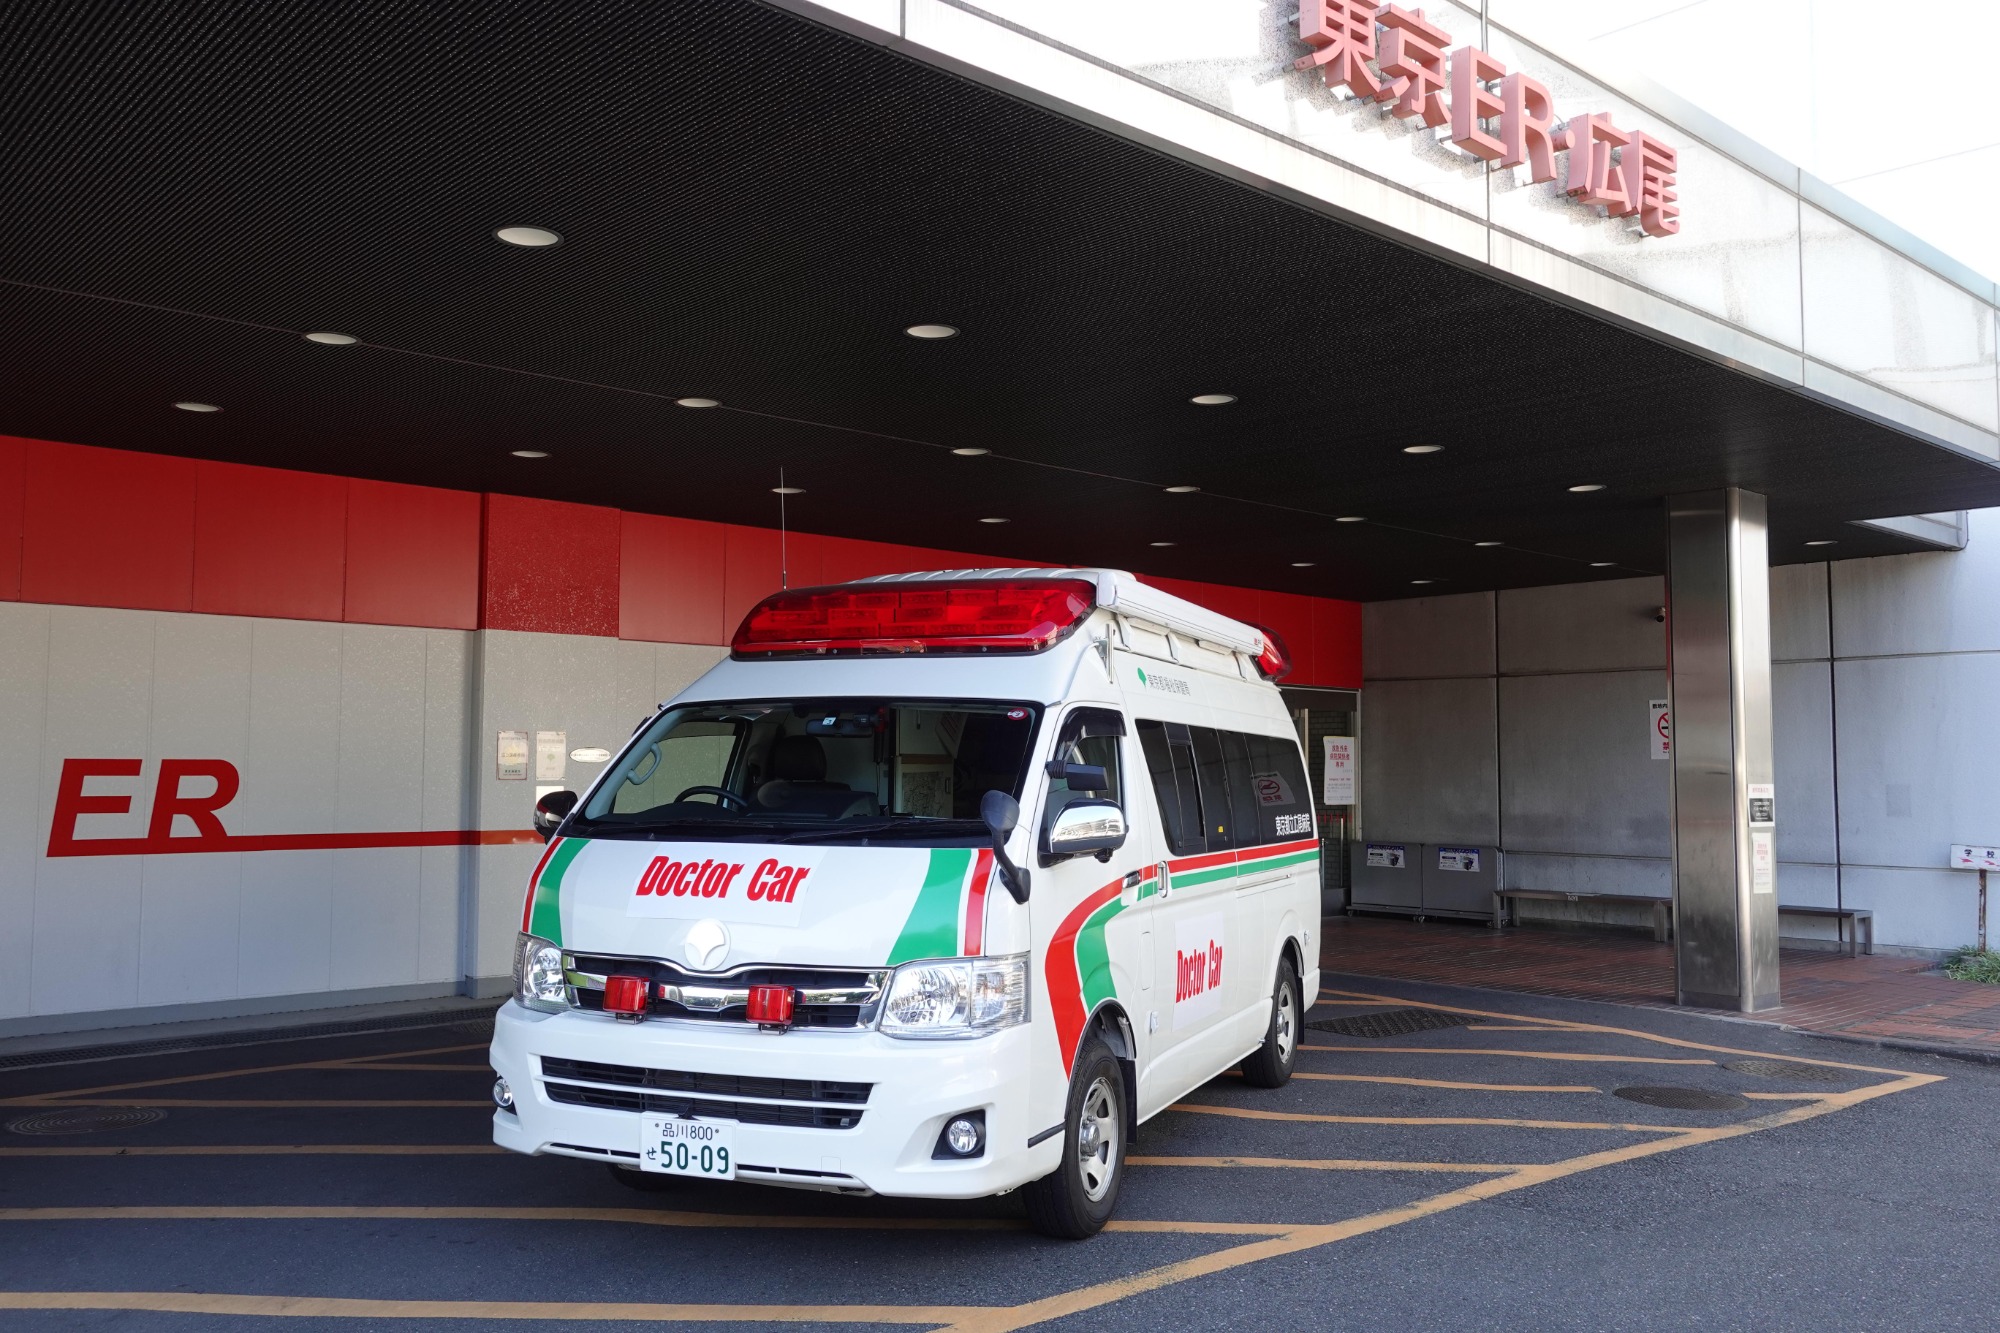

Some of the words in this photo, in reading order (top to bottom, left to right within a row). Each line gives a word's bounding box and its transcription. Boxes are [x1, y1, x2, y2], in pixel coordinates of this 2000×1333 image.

[46, 758, 240, 857] ER
[635, 855, 745, 899] Doctor
[746, 858, 811, 903] Car
[1175, 948, 1206, 1003] Doctor
[1207, 939, 1223, 991] Car
[661, 1140, 729, 1174] 50-09
